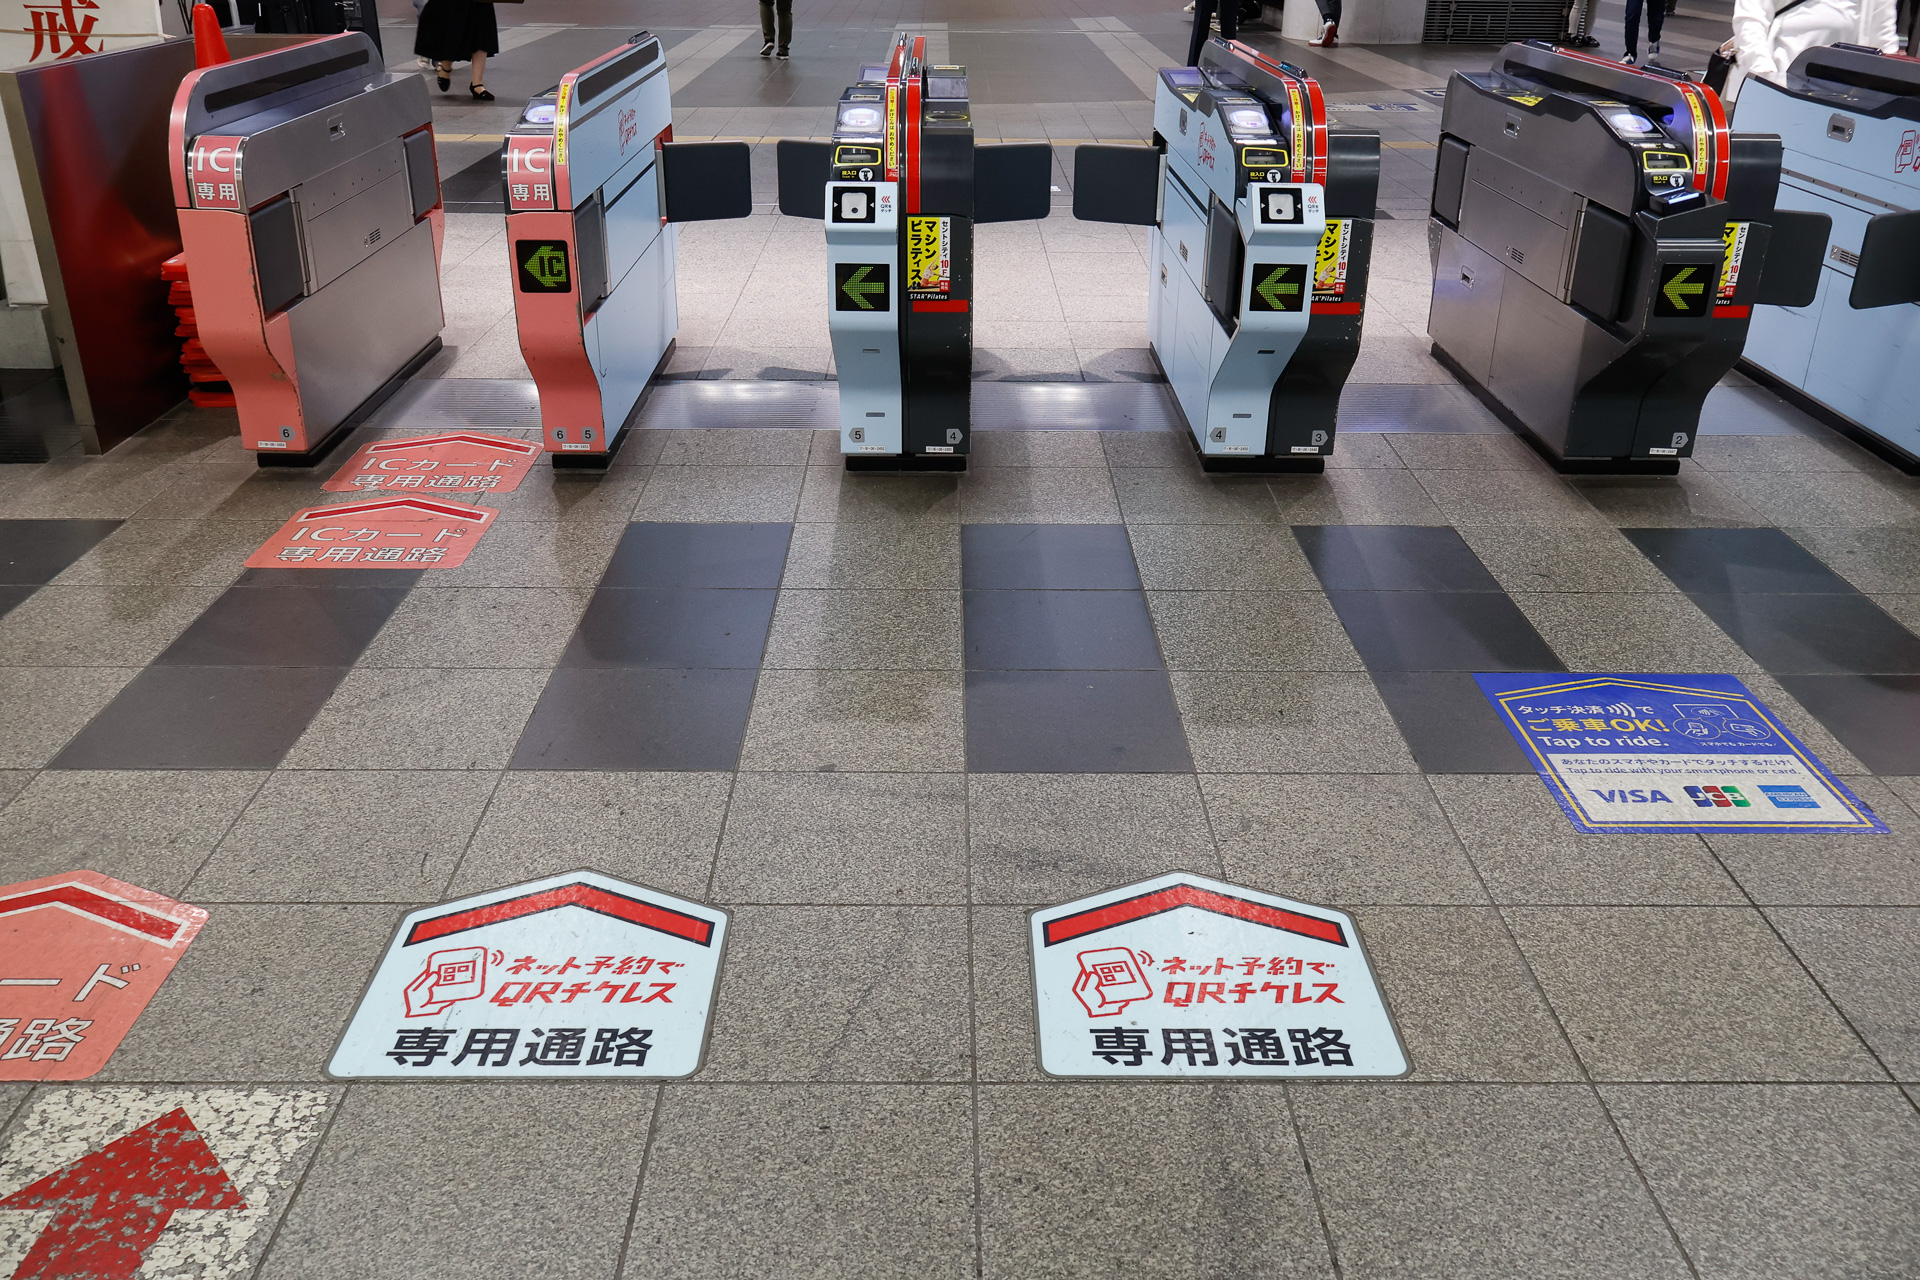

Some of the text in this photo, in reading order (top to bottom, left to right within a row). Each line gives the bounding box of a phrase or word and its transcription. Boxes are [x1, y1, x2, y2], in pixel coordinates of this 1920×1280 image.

[23, 0, 104, 62] 戒
[197, 147, 232, 172] IC
[512, 148, 546, 173] IC
[196, 182, 236, 200] 専用
[511, 184, 550, 201] 専用
[925, 221, 937, 260] マシン
[1323, 223, 1339, 262] マシン
[1340, 222, 1350, 260] セントシティ
[1734, 226, 1747, 264] セントシティ
[910, 220, 923, 280] ピラティス
[538, 256, 564, 277] IC
[282, 428, 290, 438] 6
[556, 430, 564, 439] 6
[584, 430, 592, 439] 5
[854, 430, 862, 439] 5
[950, 431, 957, 440] 4
[1215, 430, 1222, 439] 4
[1315, 433, 1322, 442] 3
[1675, 435, 1683, 444] 2
[362, 457, 518, 472] ICカード
[350, 474, 503, 490] 専用通路
[290, 527, 468, 543] ICカード
[274, 546, 449, 563] 専用通路
[1517, 705, 1606, 715] タッチ決済
[1527, 717, 1671, 732] ご乗車OK!
[1537, 735, 1670, 749] Tap to ride.
[1565, 767, 1588, 775] Tap
[1588, 785, 1752, 808] VISA JCB
[505, 955, 686, 976] ネット予約で
[1161, 956, 1335, 976] ネット予約で
[489, 981, 678, 1008] QRチケレス
[1163, 981, 1346, 1007] QRチケレス
[385, 1027, 653, 1067] 専用通路
[1089, 1026, 1354, 1067] 専用通路
